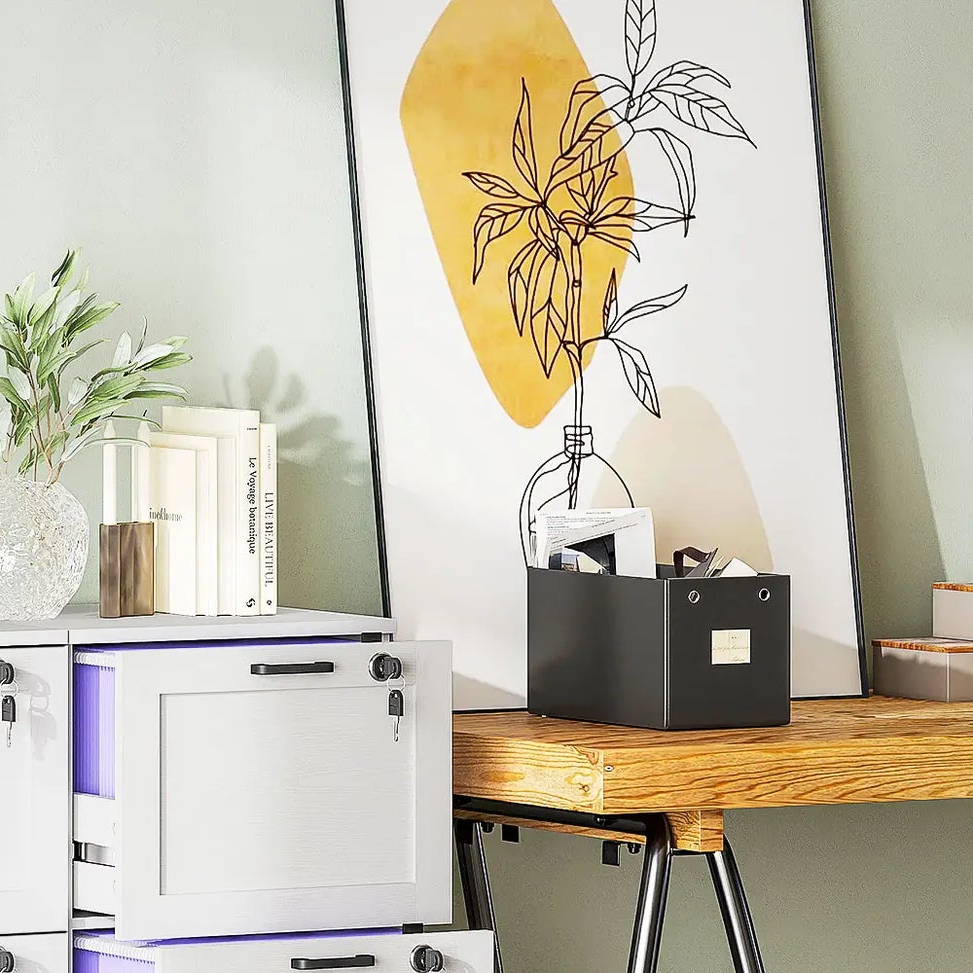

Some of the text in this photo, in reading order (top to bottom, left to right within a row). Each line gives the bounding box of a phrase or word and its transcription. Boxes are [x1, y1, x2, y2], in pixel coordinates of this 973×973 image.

[246, 457, 257, 555] Le Voyage botanique
[264, 492, 274, 588] LIVE BEAUTIFUL
